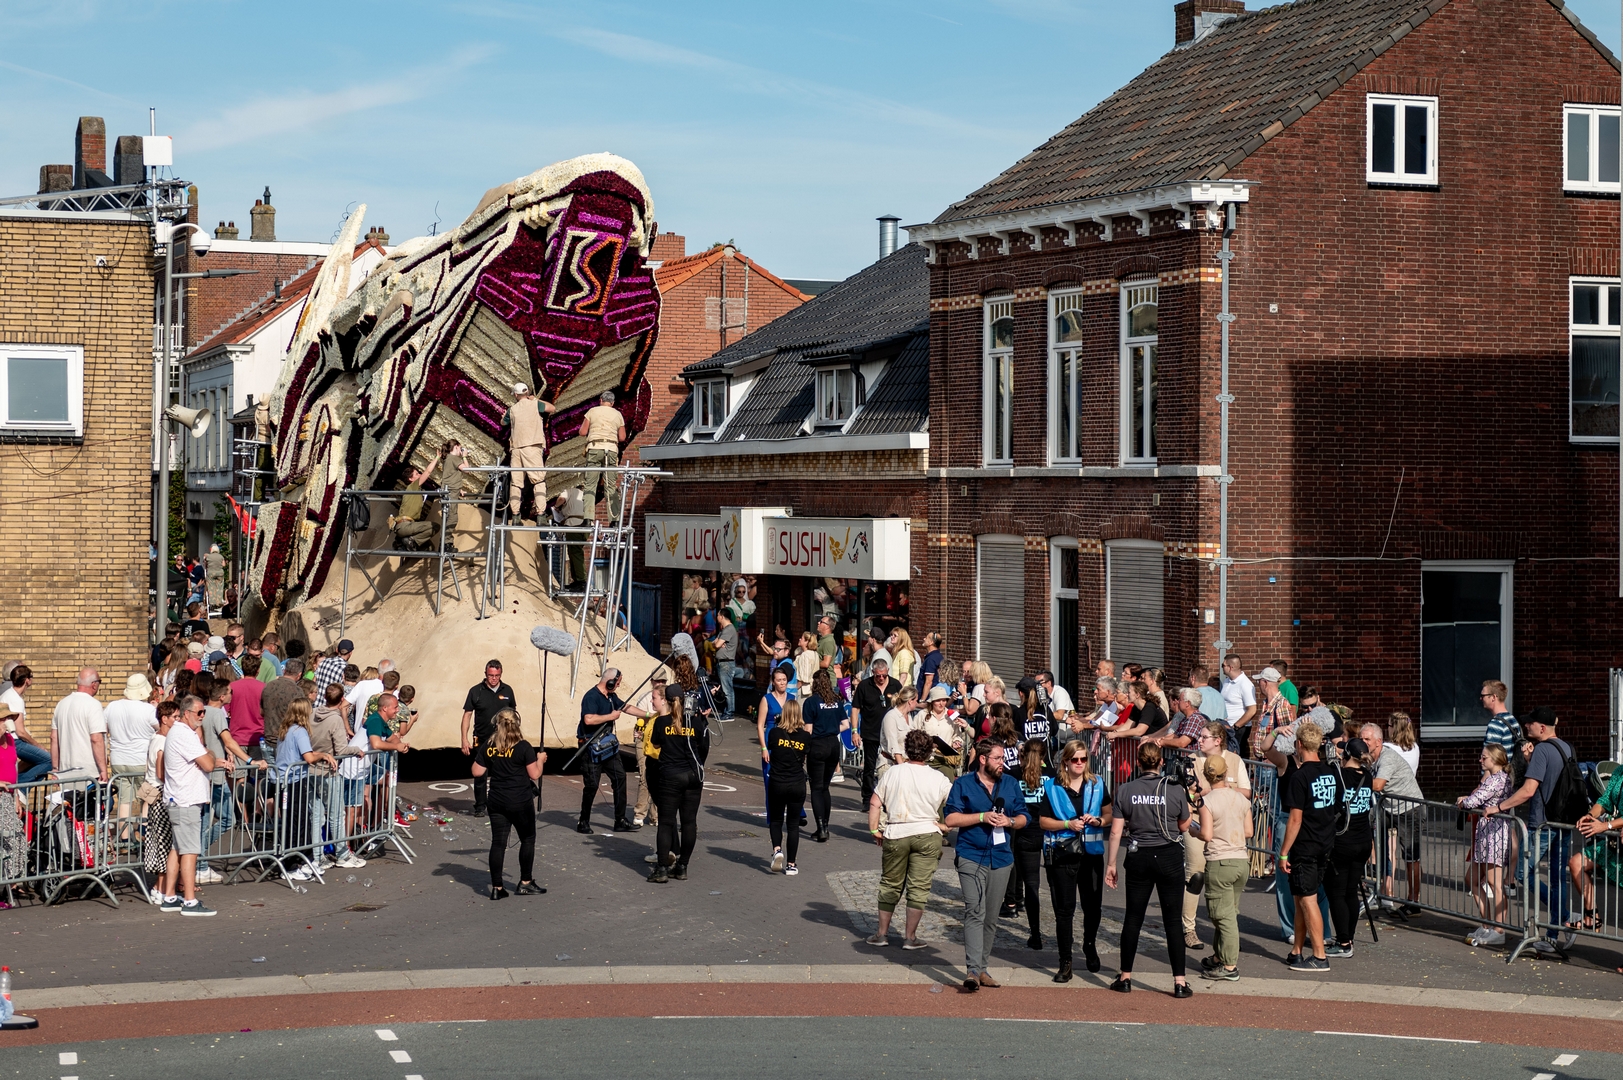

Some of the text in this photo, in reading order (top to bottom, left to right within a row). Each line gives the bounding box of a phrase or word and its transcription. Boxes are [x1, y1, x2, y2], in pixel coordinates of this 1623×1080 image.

[685, 528, 721, 562] LUCK
[779, 531, 826, 567] SUSHI
[664, 726, 696, 737] CAERA
[1024, 720, 1050, 734] NEWS
[1131, 794, 1166, 806] CAMERA
